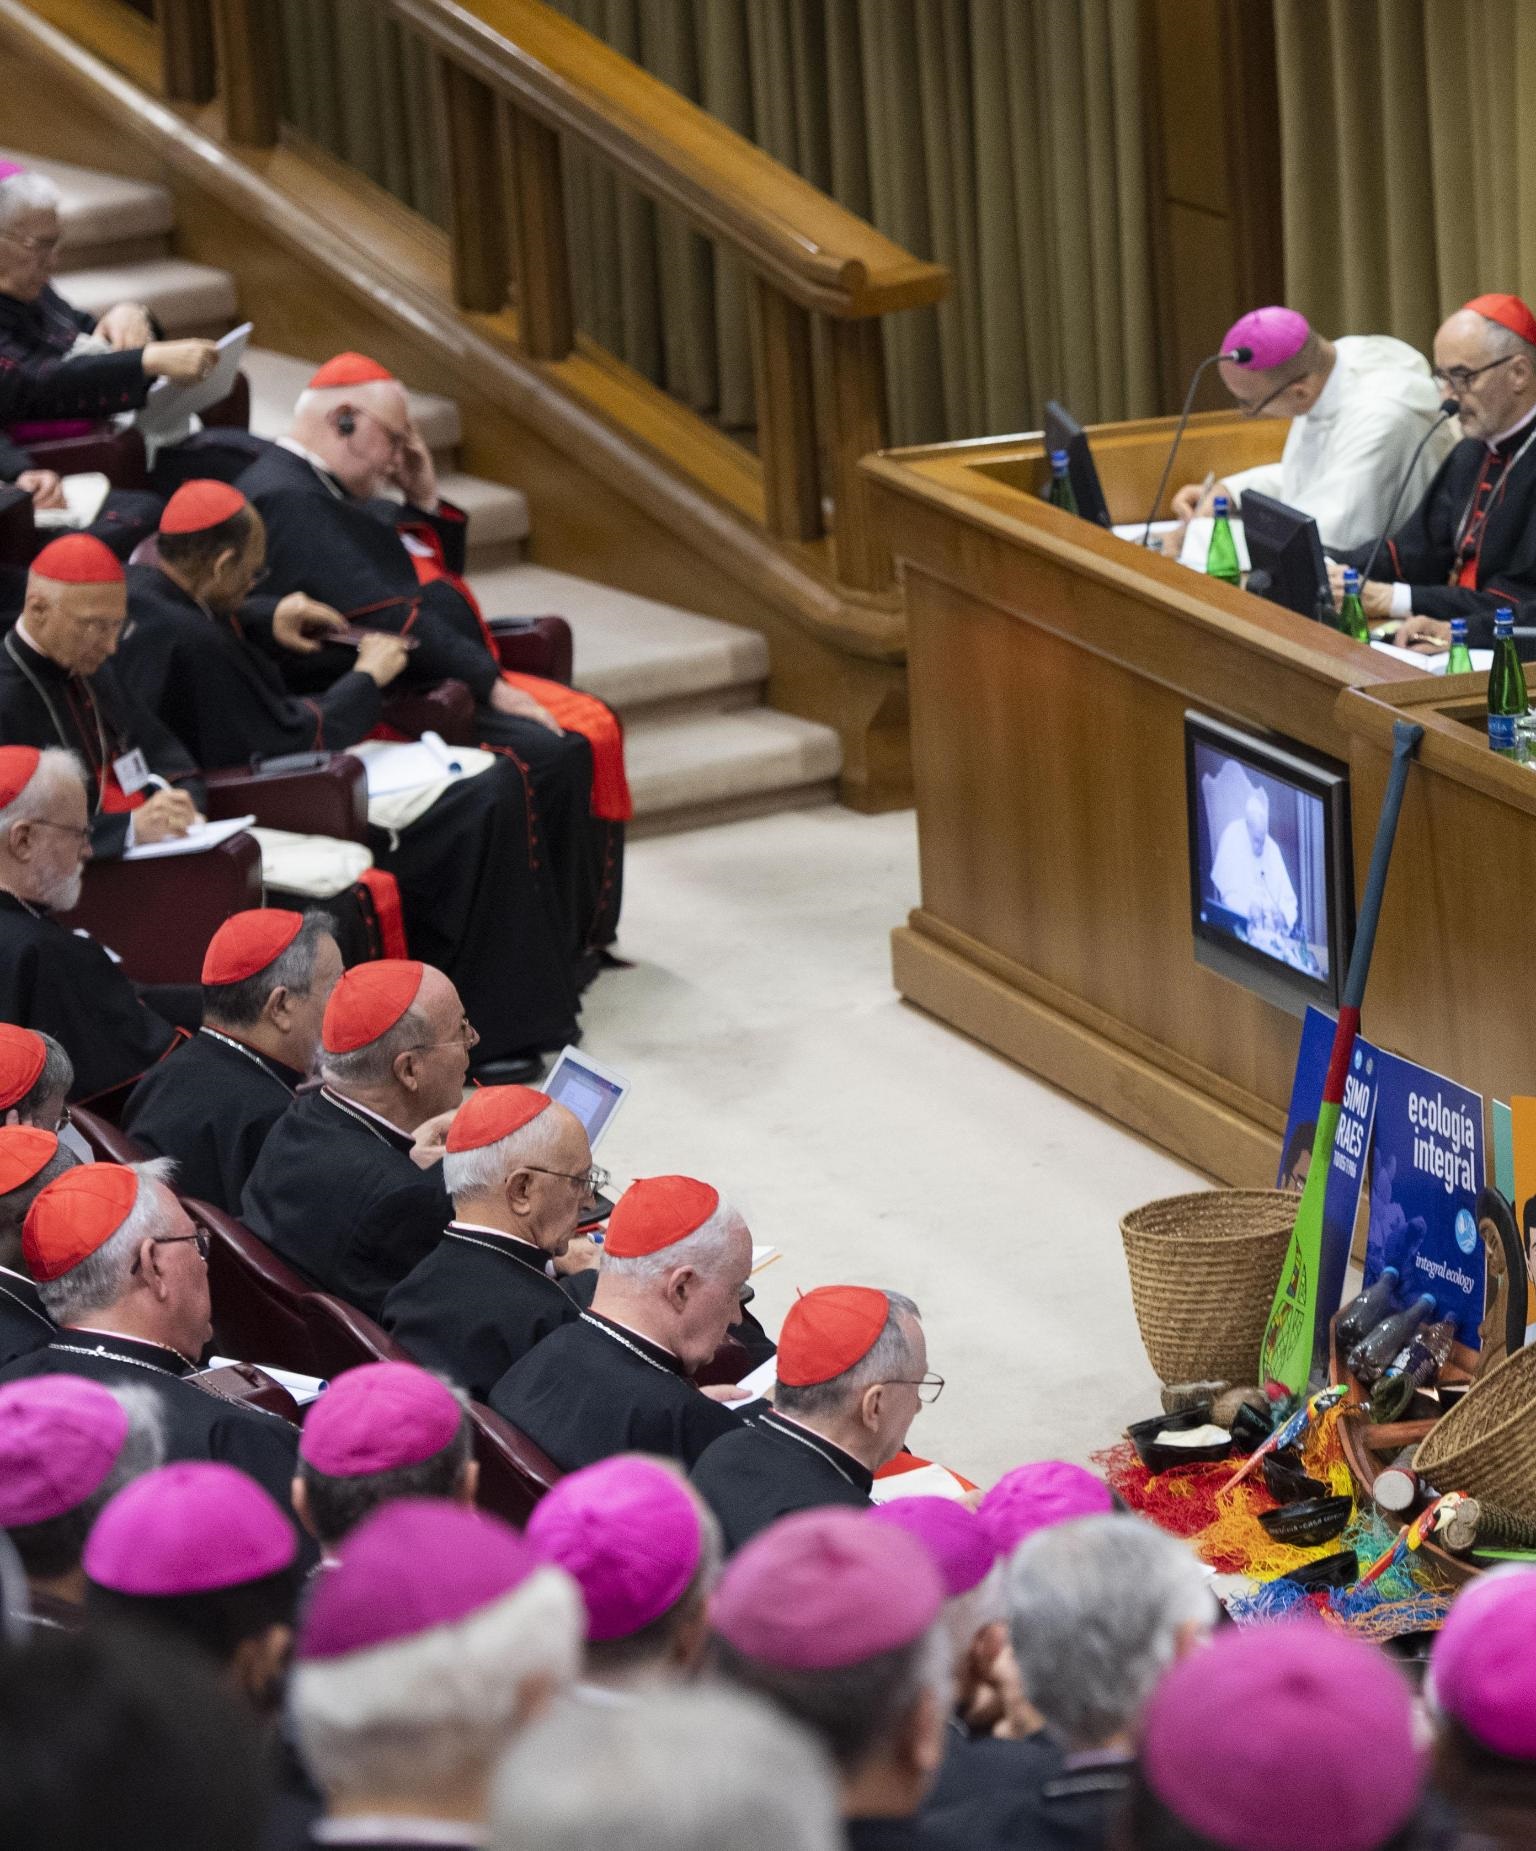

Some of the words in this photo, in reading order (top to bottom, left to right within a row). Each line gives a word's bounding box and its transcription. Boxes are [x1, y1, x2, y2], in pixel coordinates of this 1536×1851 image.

[1408, 1091, 1474, 1154] ecología
[1413, 1126, 1476, 1195] integral
[1415, 1252, 1446, 1281] integral
[1445, 1267, 1475, 1294] ecology
